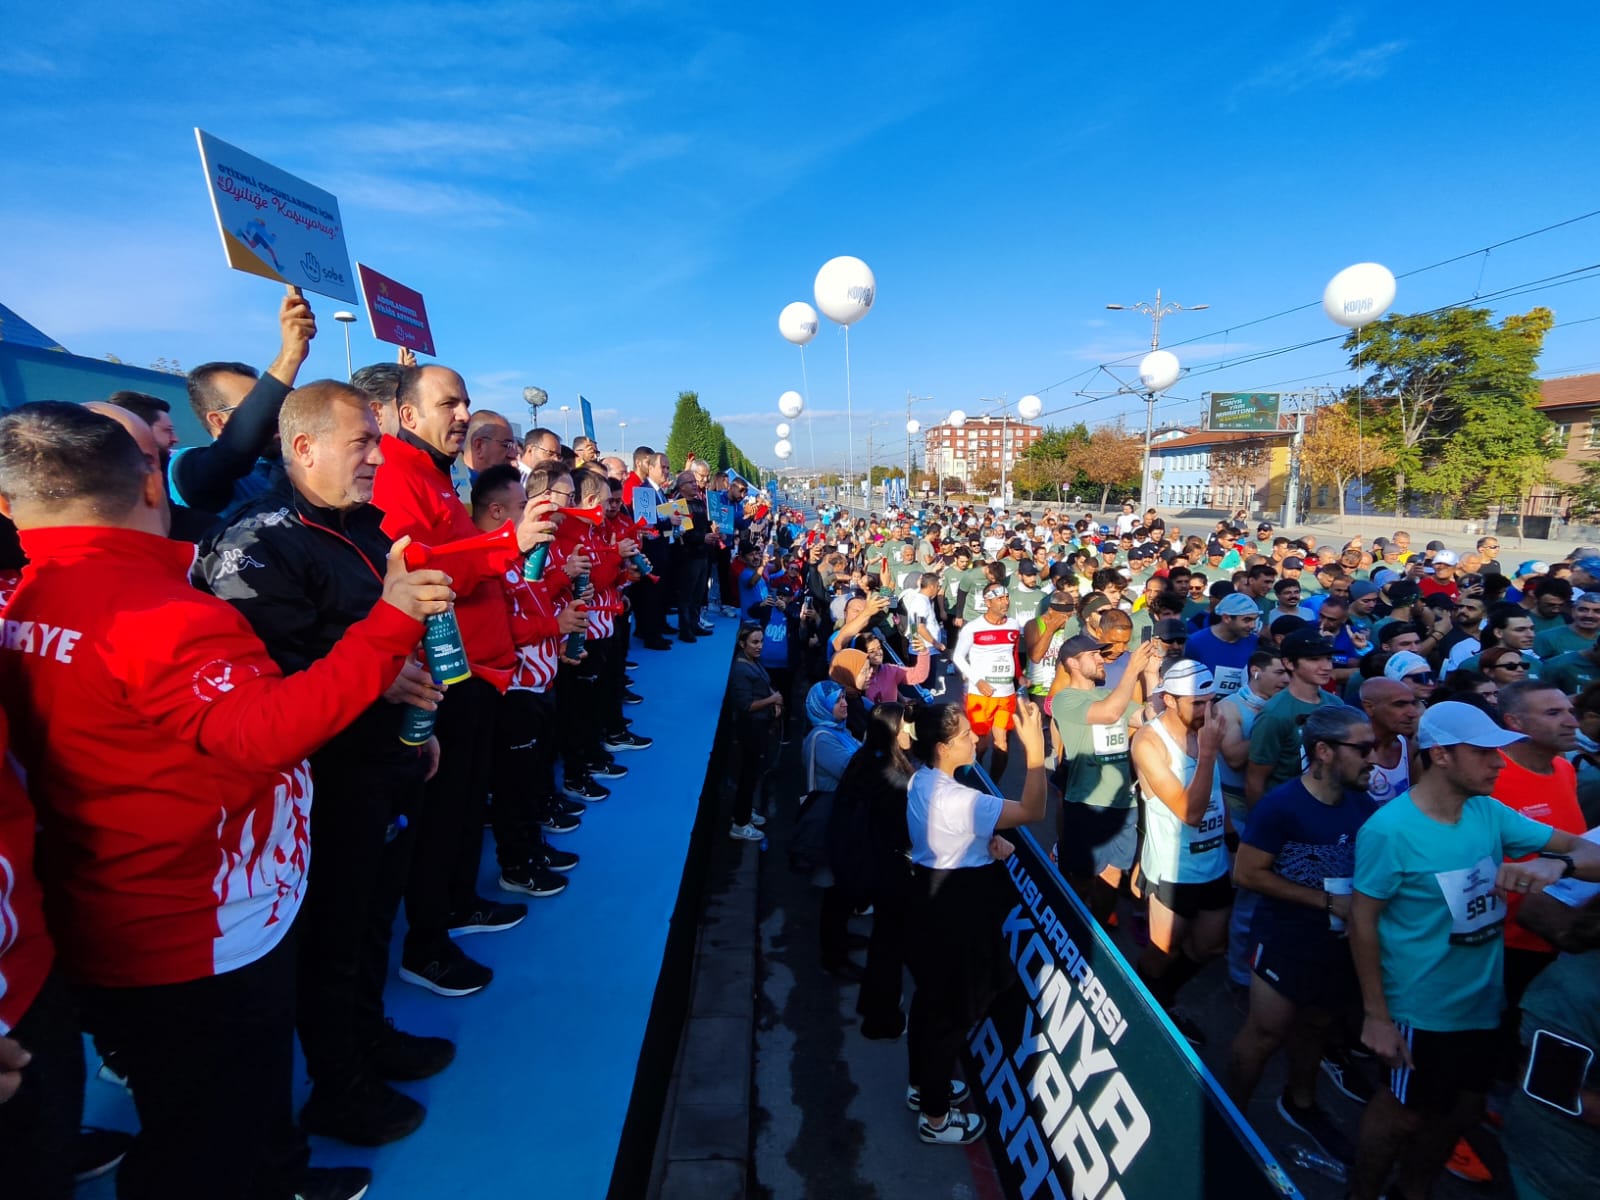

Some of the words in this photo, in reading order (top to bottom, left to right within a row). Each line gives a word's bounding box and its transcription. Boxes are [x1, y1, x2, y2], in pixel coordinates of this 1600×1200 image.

[322, 267, 344, 283] sobe
[992, 664, 1010, 673] 395
[1106, 732, 1125, 747] 186
[1198, 814, 1223, 834] 203
[1466, 893, 1497, 921] 597
[1002, 903, 1151, 1175] KONYA
